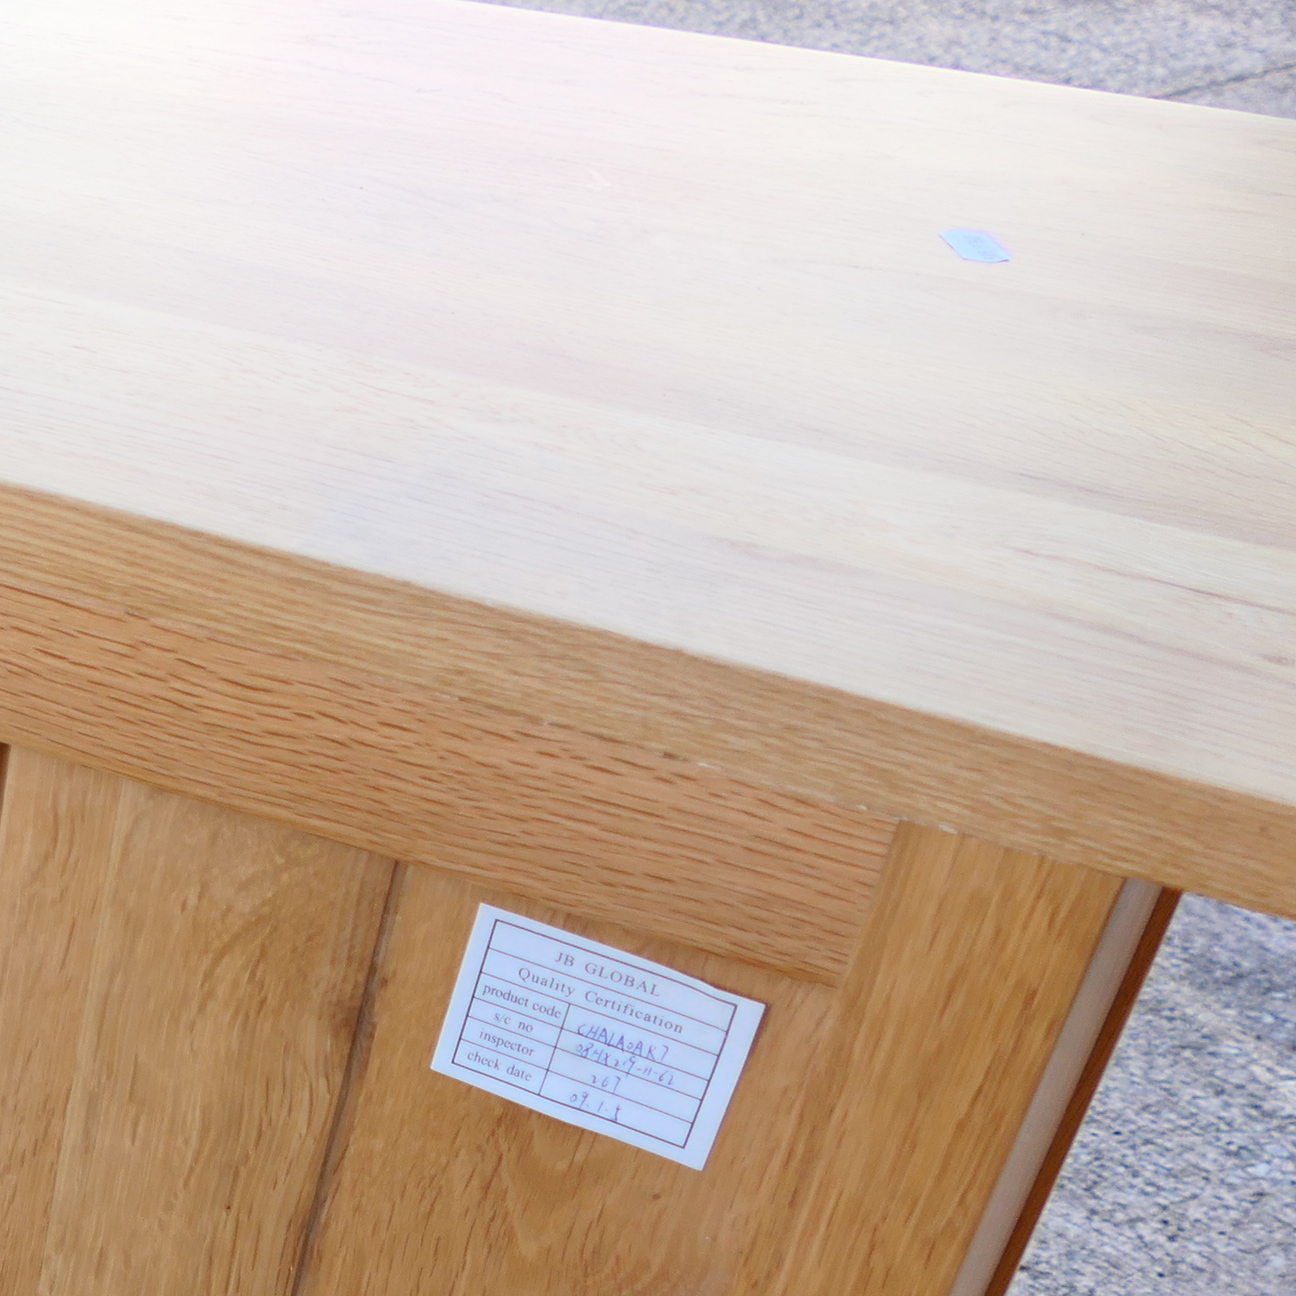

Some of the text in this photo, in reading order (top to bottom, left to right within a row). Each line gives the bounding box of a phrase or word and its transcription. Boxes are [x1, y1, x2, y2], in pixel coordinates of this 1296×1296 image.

[555, 951, 660, 997] JB GLOBAL
[481, 984, 562, 1019] product code
[518, 967, 684, 1034] Quality Certification
[493, 1012, 534, 1033] s/c no
[479, 1028, 535, 1057] inspector
[467, 1051, 533, 1081] check date
